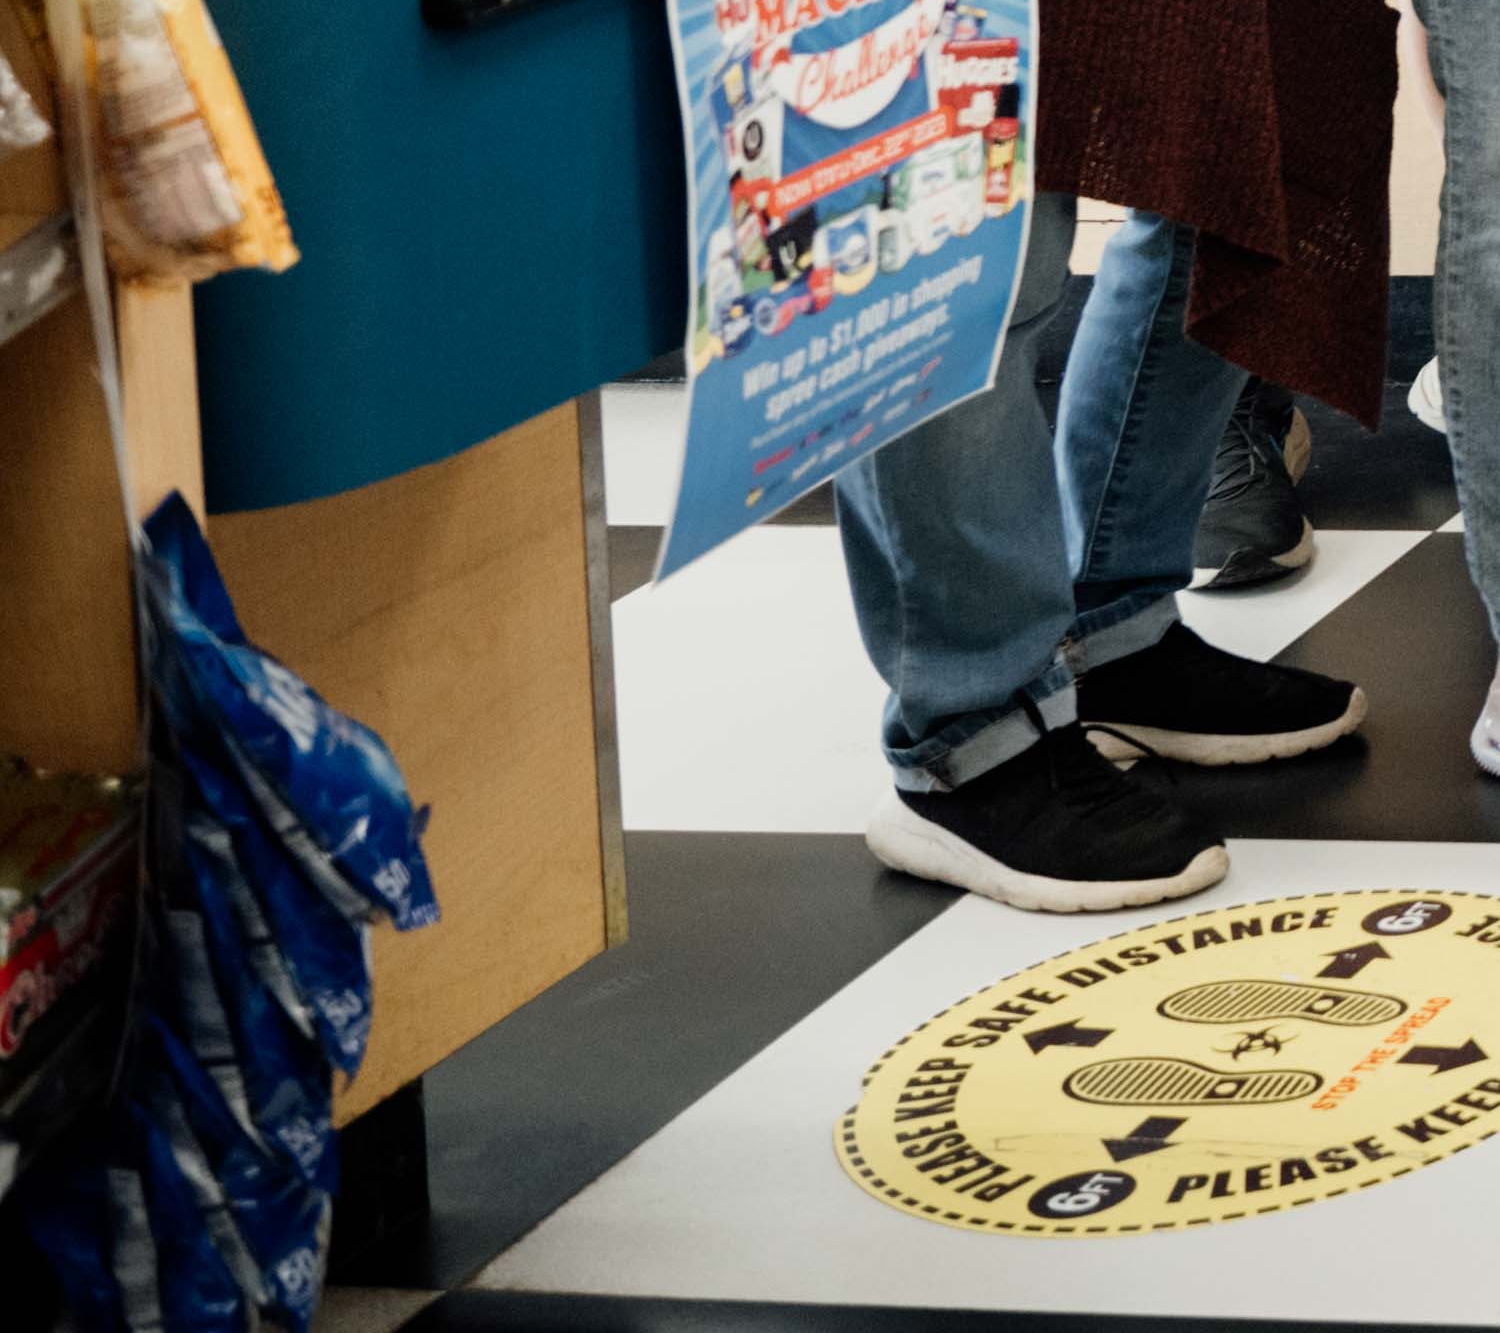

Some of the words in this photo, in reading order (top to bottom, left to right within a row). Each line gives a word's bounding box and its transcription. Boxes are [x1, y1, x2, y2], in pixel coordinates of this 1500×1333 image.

[1056, 906, 1340, 990] DISTANCE
[1375, 900, 1442, 934] 6FT
[942, 986, 1068, 1049] SAFE
[1311, 1075, 1358, 1111] STOP
[1351, 1045, 1385, 1075] THE
[1381, 996, 1453, 1051] SPREAD
[894, 1056, 973, 1123] KEEP
[895, 1119, 1036, 1203] PLEASE
[1046, 1172, 1126, 1213] 6FT
[1166, 1135, 1396, 1204] PLEASE
